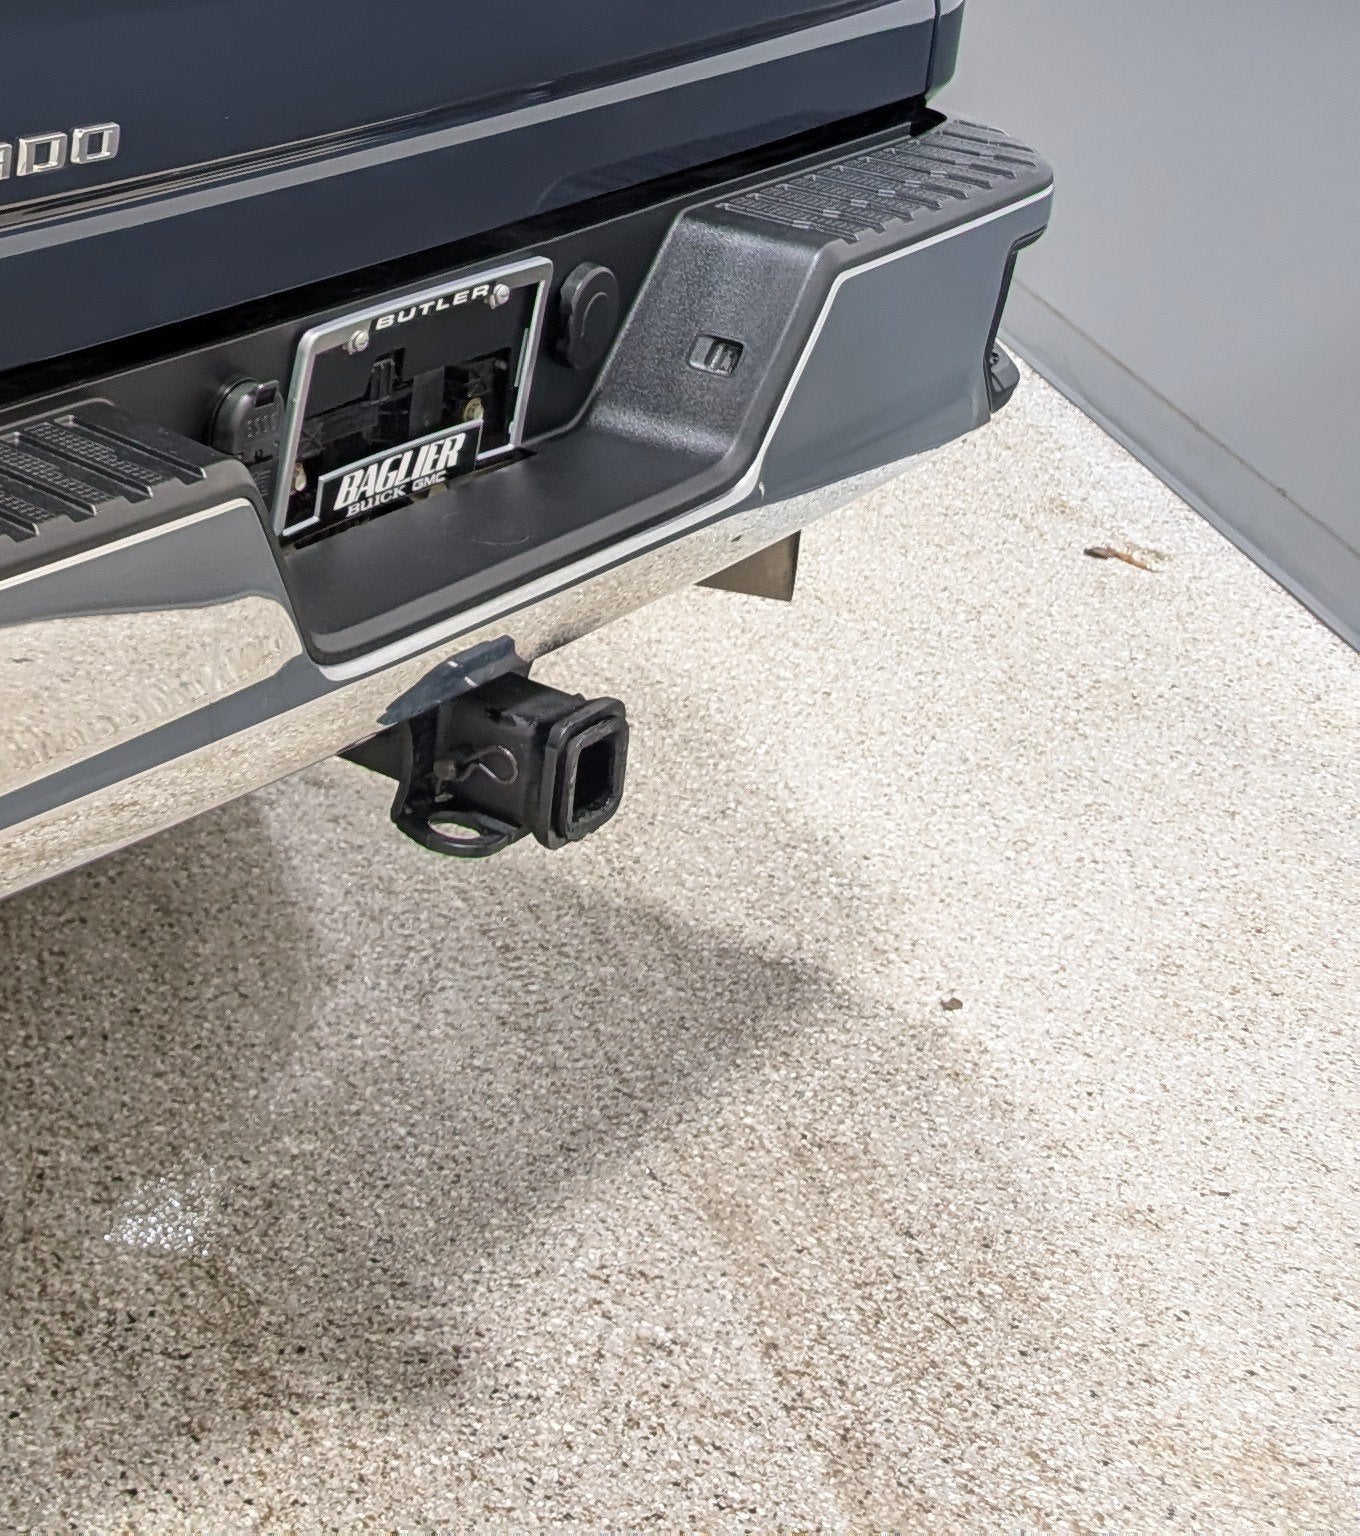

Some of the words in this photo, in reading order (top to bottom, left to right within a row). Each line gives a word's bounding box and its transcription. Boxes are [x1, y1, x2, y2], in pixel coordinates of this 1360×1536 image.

[375, 284, 490, 330] BUTLER
[333, 433, 466, 511] BAGLIER
[346, 484, 406, 518] BUICK
[412, 470, 447, 492] GMC
